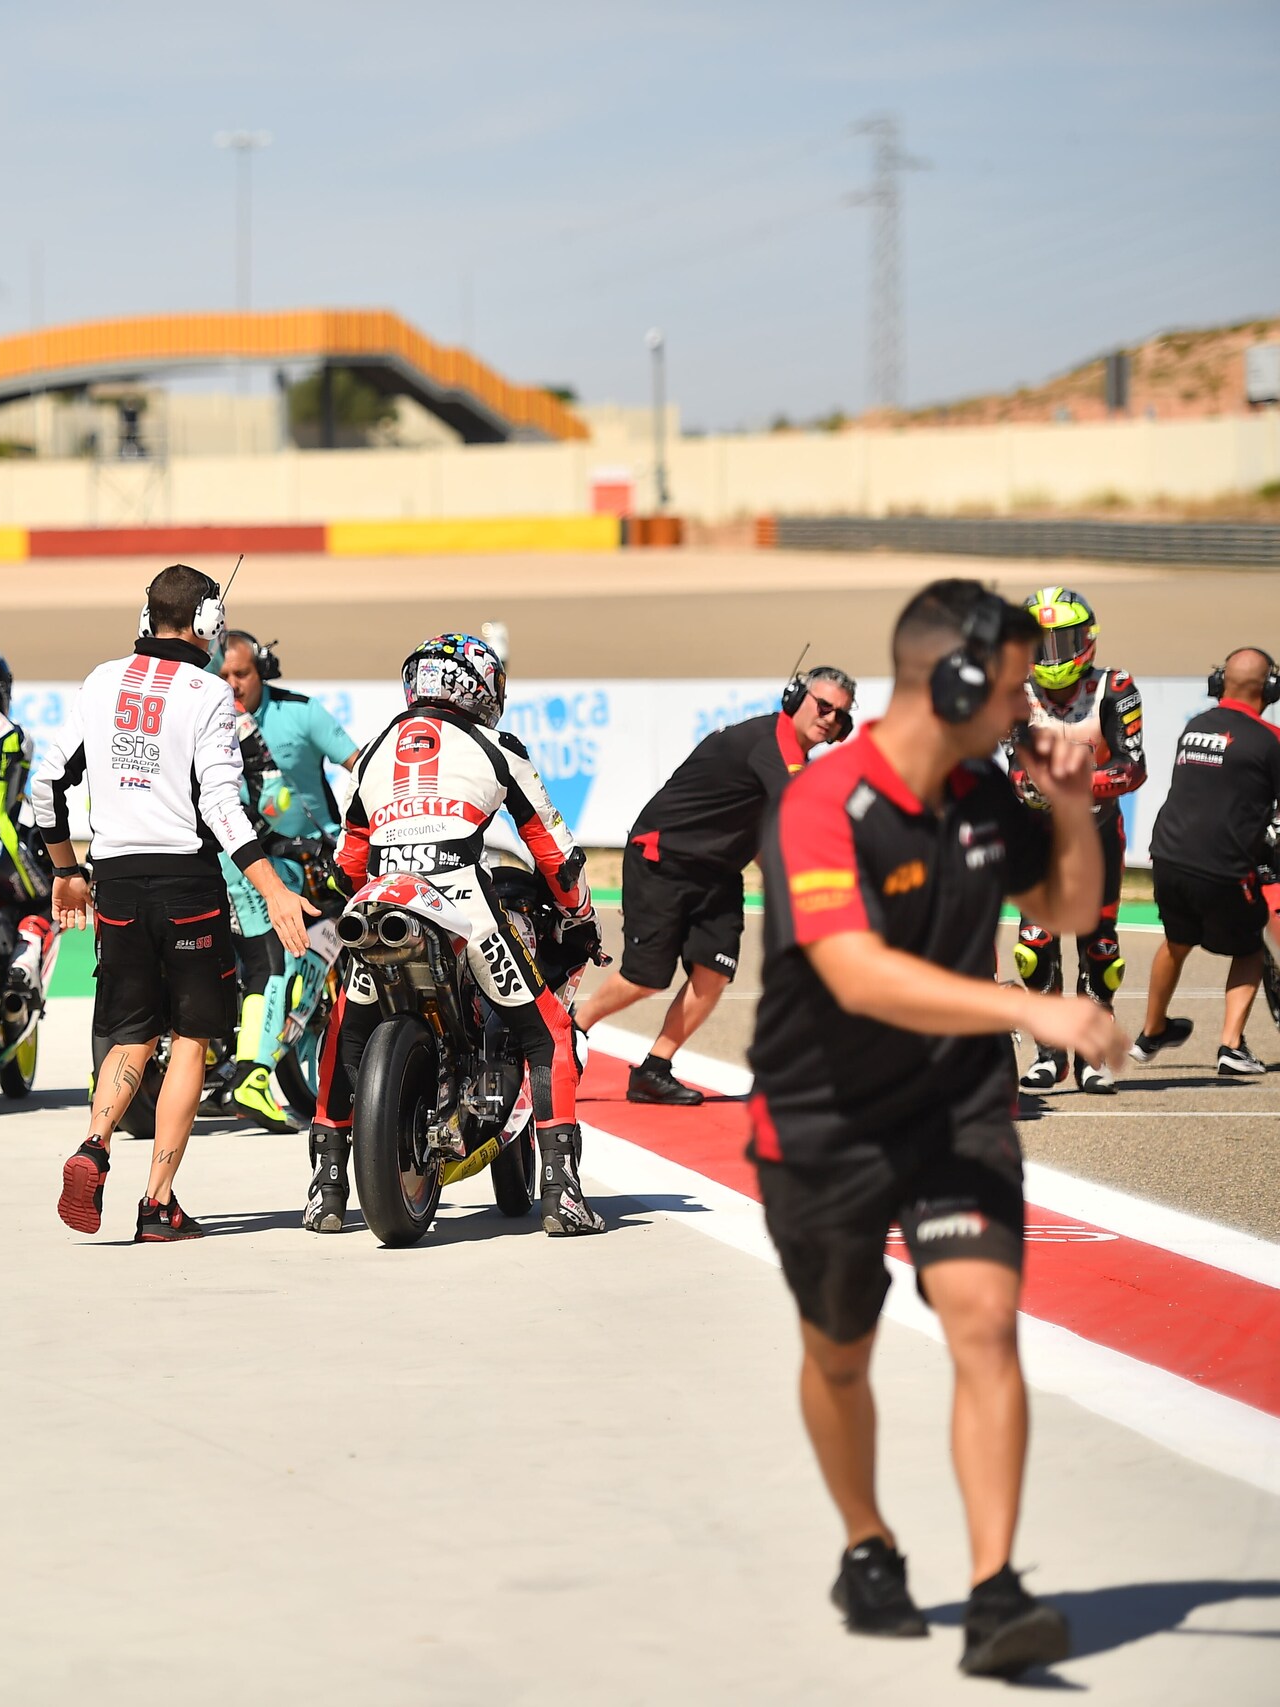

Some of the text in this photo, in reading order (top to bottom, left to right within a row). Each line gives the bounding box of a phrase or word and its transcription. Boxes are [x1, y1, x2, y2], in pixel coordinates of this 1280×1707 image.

[114, 688, 166, 737] 58
[111, 732, 160, 761] Sic
[1181, 731, 1228, 750] MTA
[111, 757, 160, 768] SQUADRA
[111, 763, 161, 775] CORSE
[120, 776, 151, 789] HRC
[374, 796, 465, 828] ONGETTA
